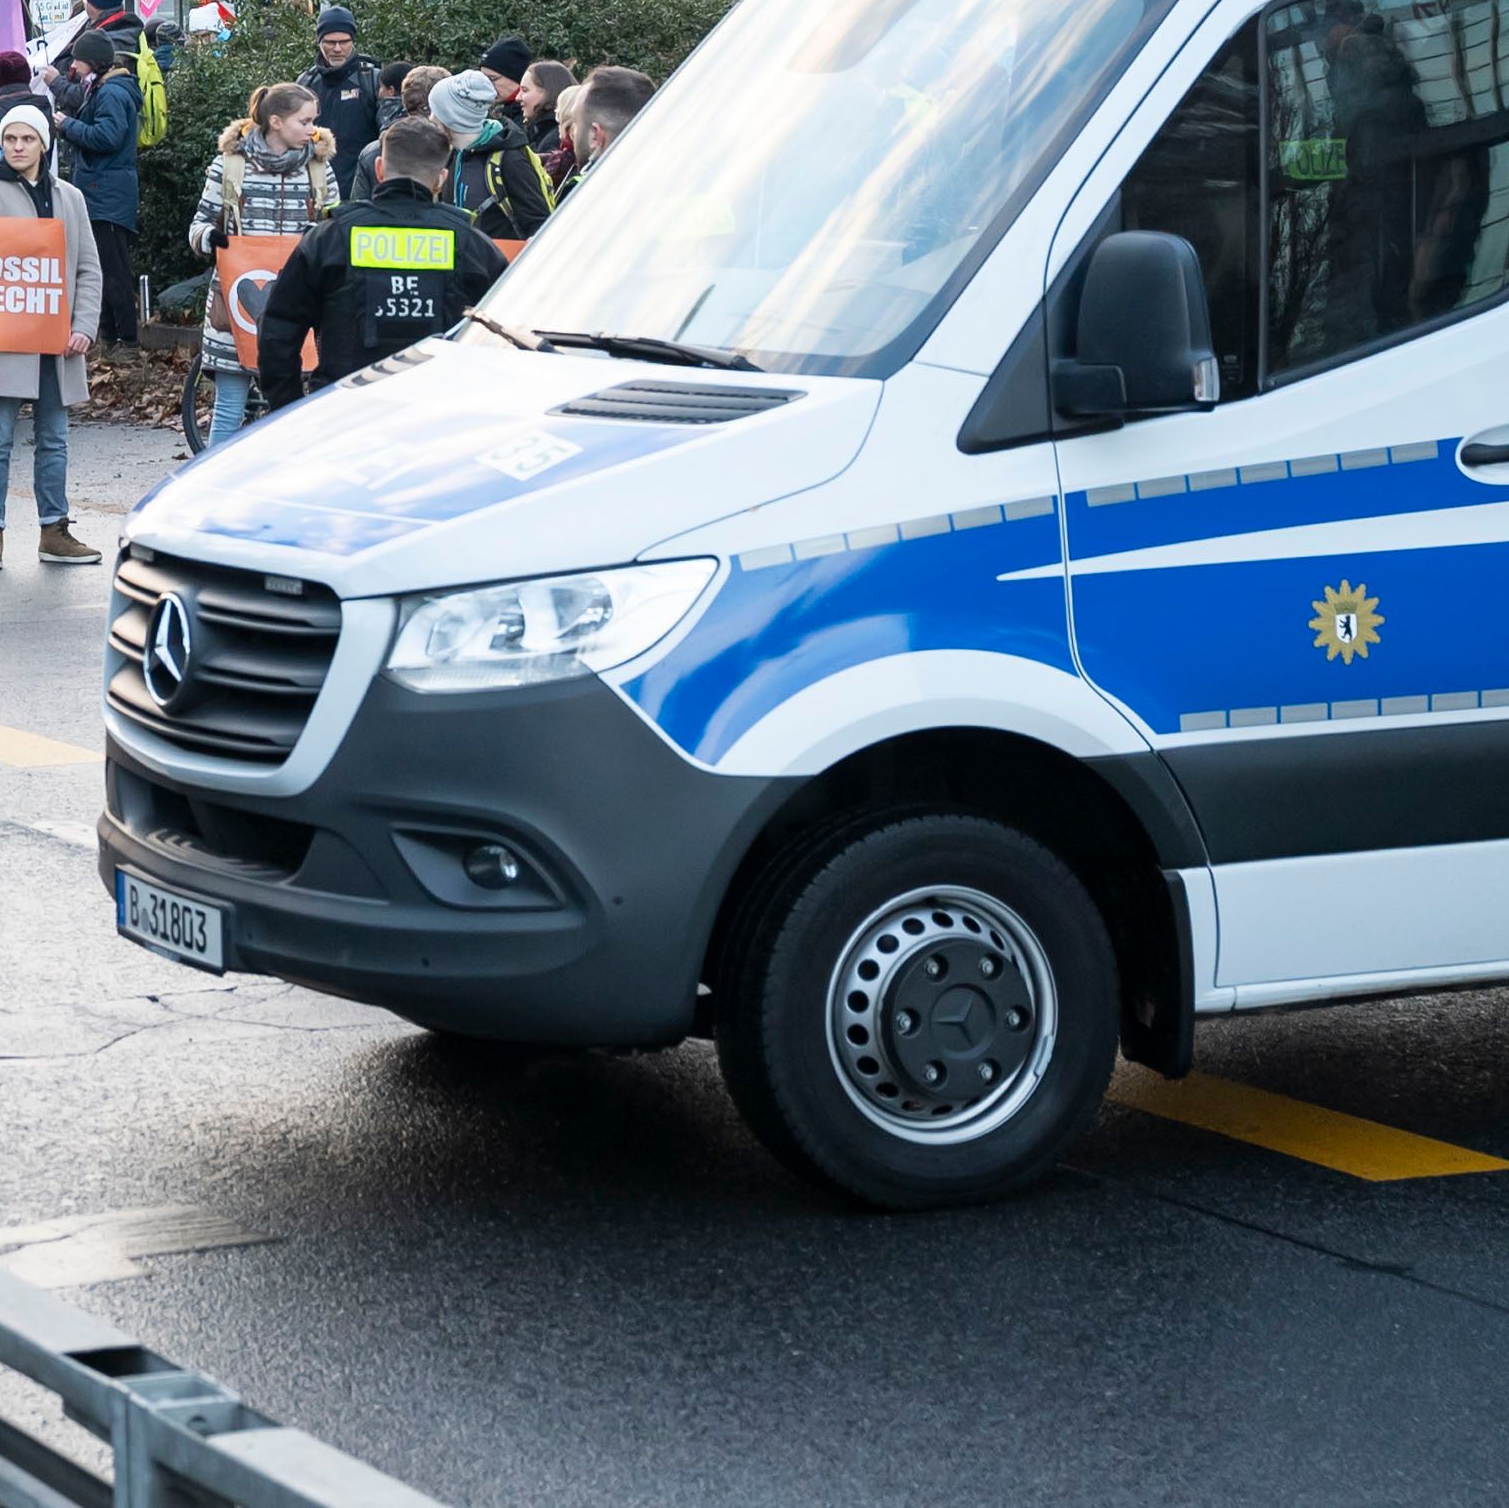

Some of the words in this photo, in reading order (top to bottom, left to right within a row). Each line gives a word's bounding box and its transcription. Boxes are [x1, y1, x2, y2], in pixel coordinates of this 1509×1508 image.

[356, 233, 449, 263] POLIZEI
[390, 275, 419, 296] BE
[130, 883, 140, 928] B
[148, 892, 207, 954] 31803
